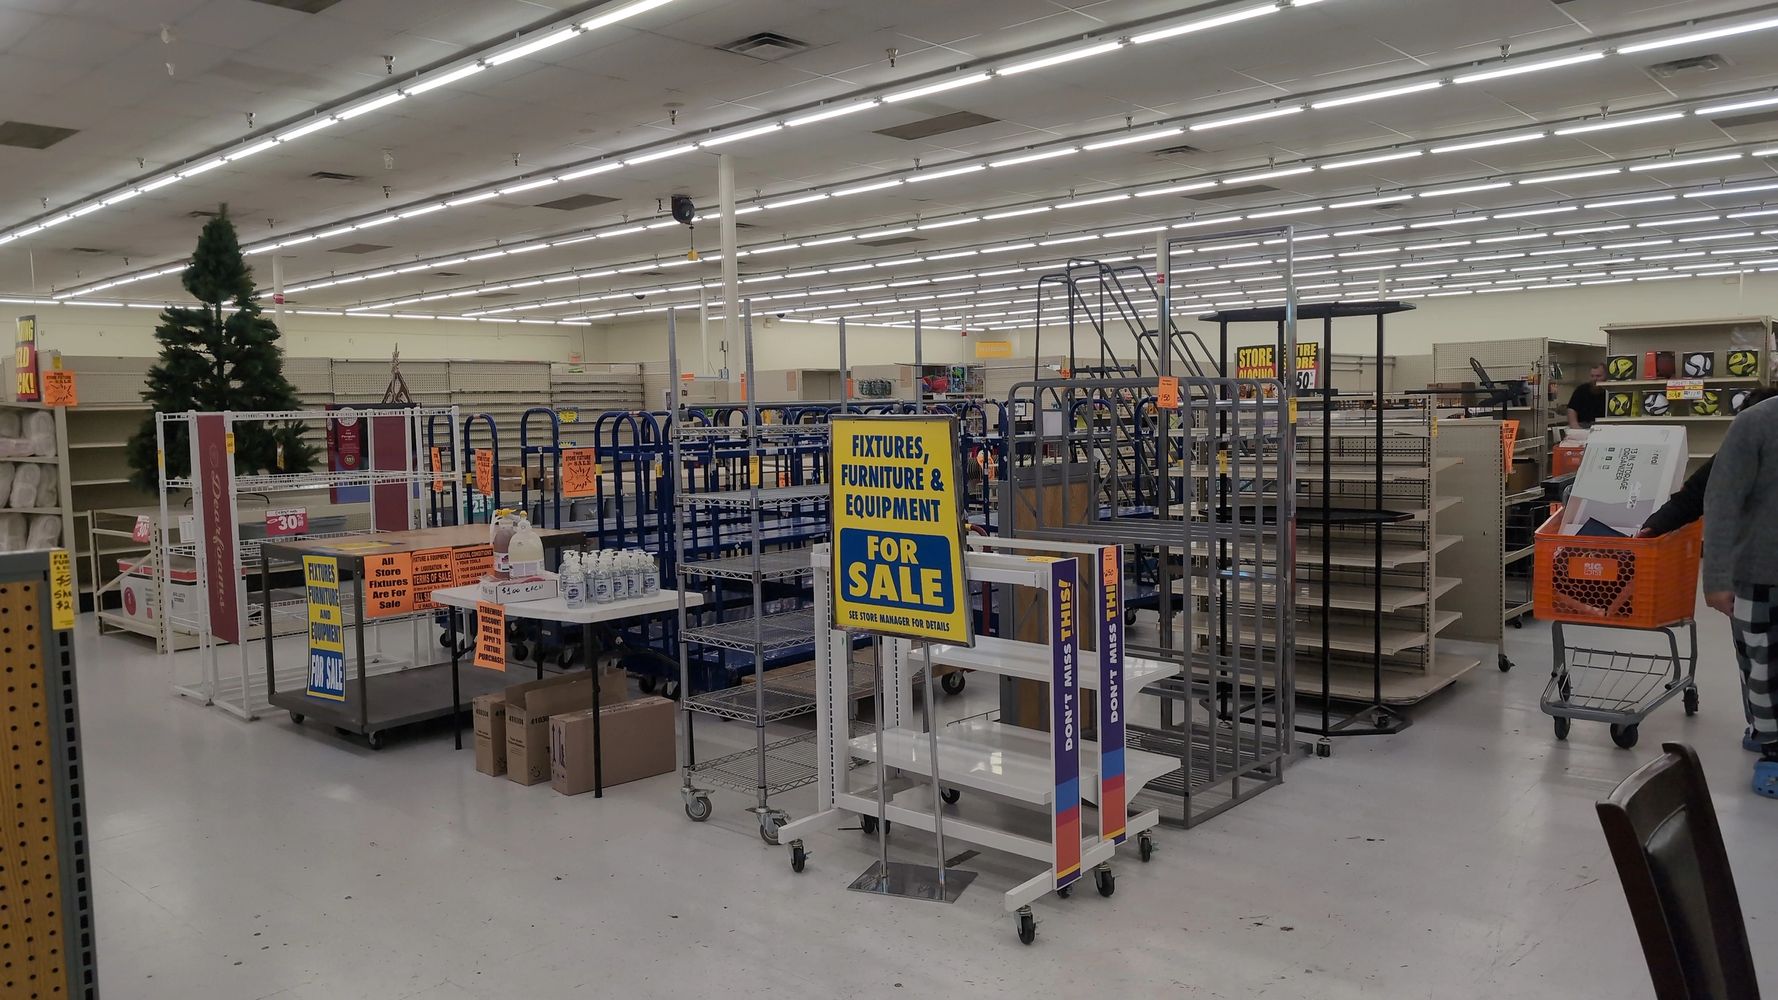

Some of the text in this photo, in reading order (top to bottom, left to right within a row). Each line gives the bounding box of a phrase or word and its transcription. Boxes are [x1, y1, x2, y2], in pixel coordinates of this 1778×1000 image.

[1239, 347, 1273, 368] STORE
[852, 434, 929, 465] FIXTURES,
[1615, 447, 1631, 481] ORGANIZER
[841, 464, 945, 491] FURNITURE &
[1619, 462, 1634, 491] STORAGE
[846, 494, 941, 522] EQUIPMENT
[867, 535, 919, 565] FOR
[382, 557, 394, 566] All
[308, 563, 335, 584] FIXTURES
[375, 568, 401, 577] Store
[414, 571, 451, 584] TERMS OF SALE
[369, 579, 408, 588] Fixtures
[373, 589, 406, 599] Are For
[848, 561, 945, 607] SALE
[308, 585, 339, 607] FURNITURE
[379, 600, 401, 609] Sale
[320, 609, 332, 620] AND
[480, 605, 502, 617] STOREWIDE
[481, 615, 501, 626] DISCOUNT
[849, 610, 950, 632] SEE STORE MANAGER FOR DETAILS
[311, 621, 341, 645] EQUIPMENT
[482, 625, 501, 636] DOES NOT
[484, 634, 501, 645] APPLY TO
[478, 652, 504, 665] PURCHASES
[484, 644, 500, 655] FIXTURE
[1106, 584, 1119, 723] DON'T MISS THI
[311, 653, 344, 691] FOR SALE
[1059, 578, 1073, 751] DON'T MISS THIS!
